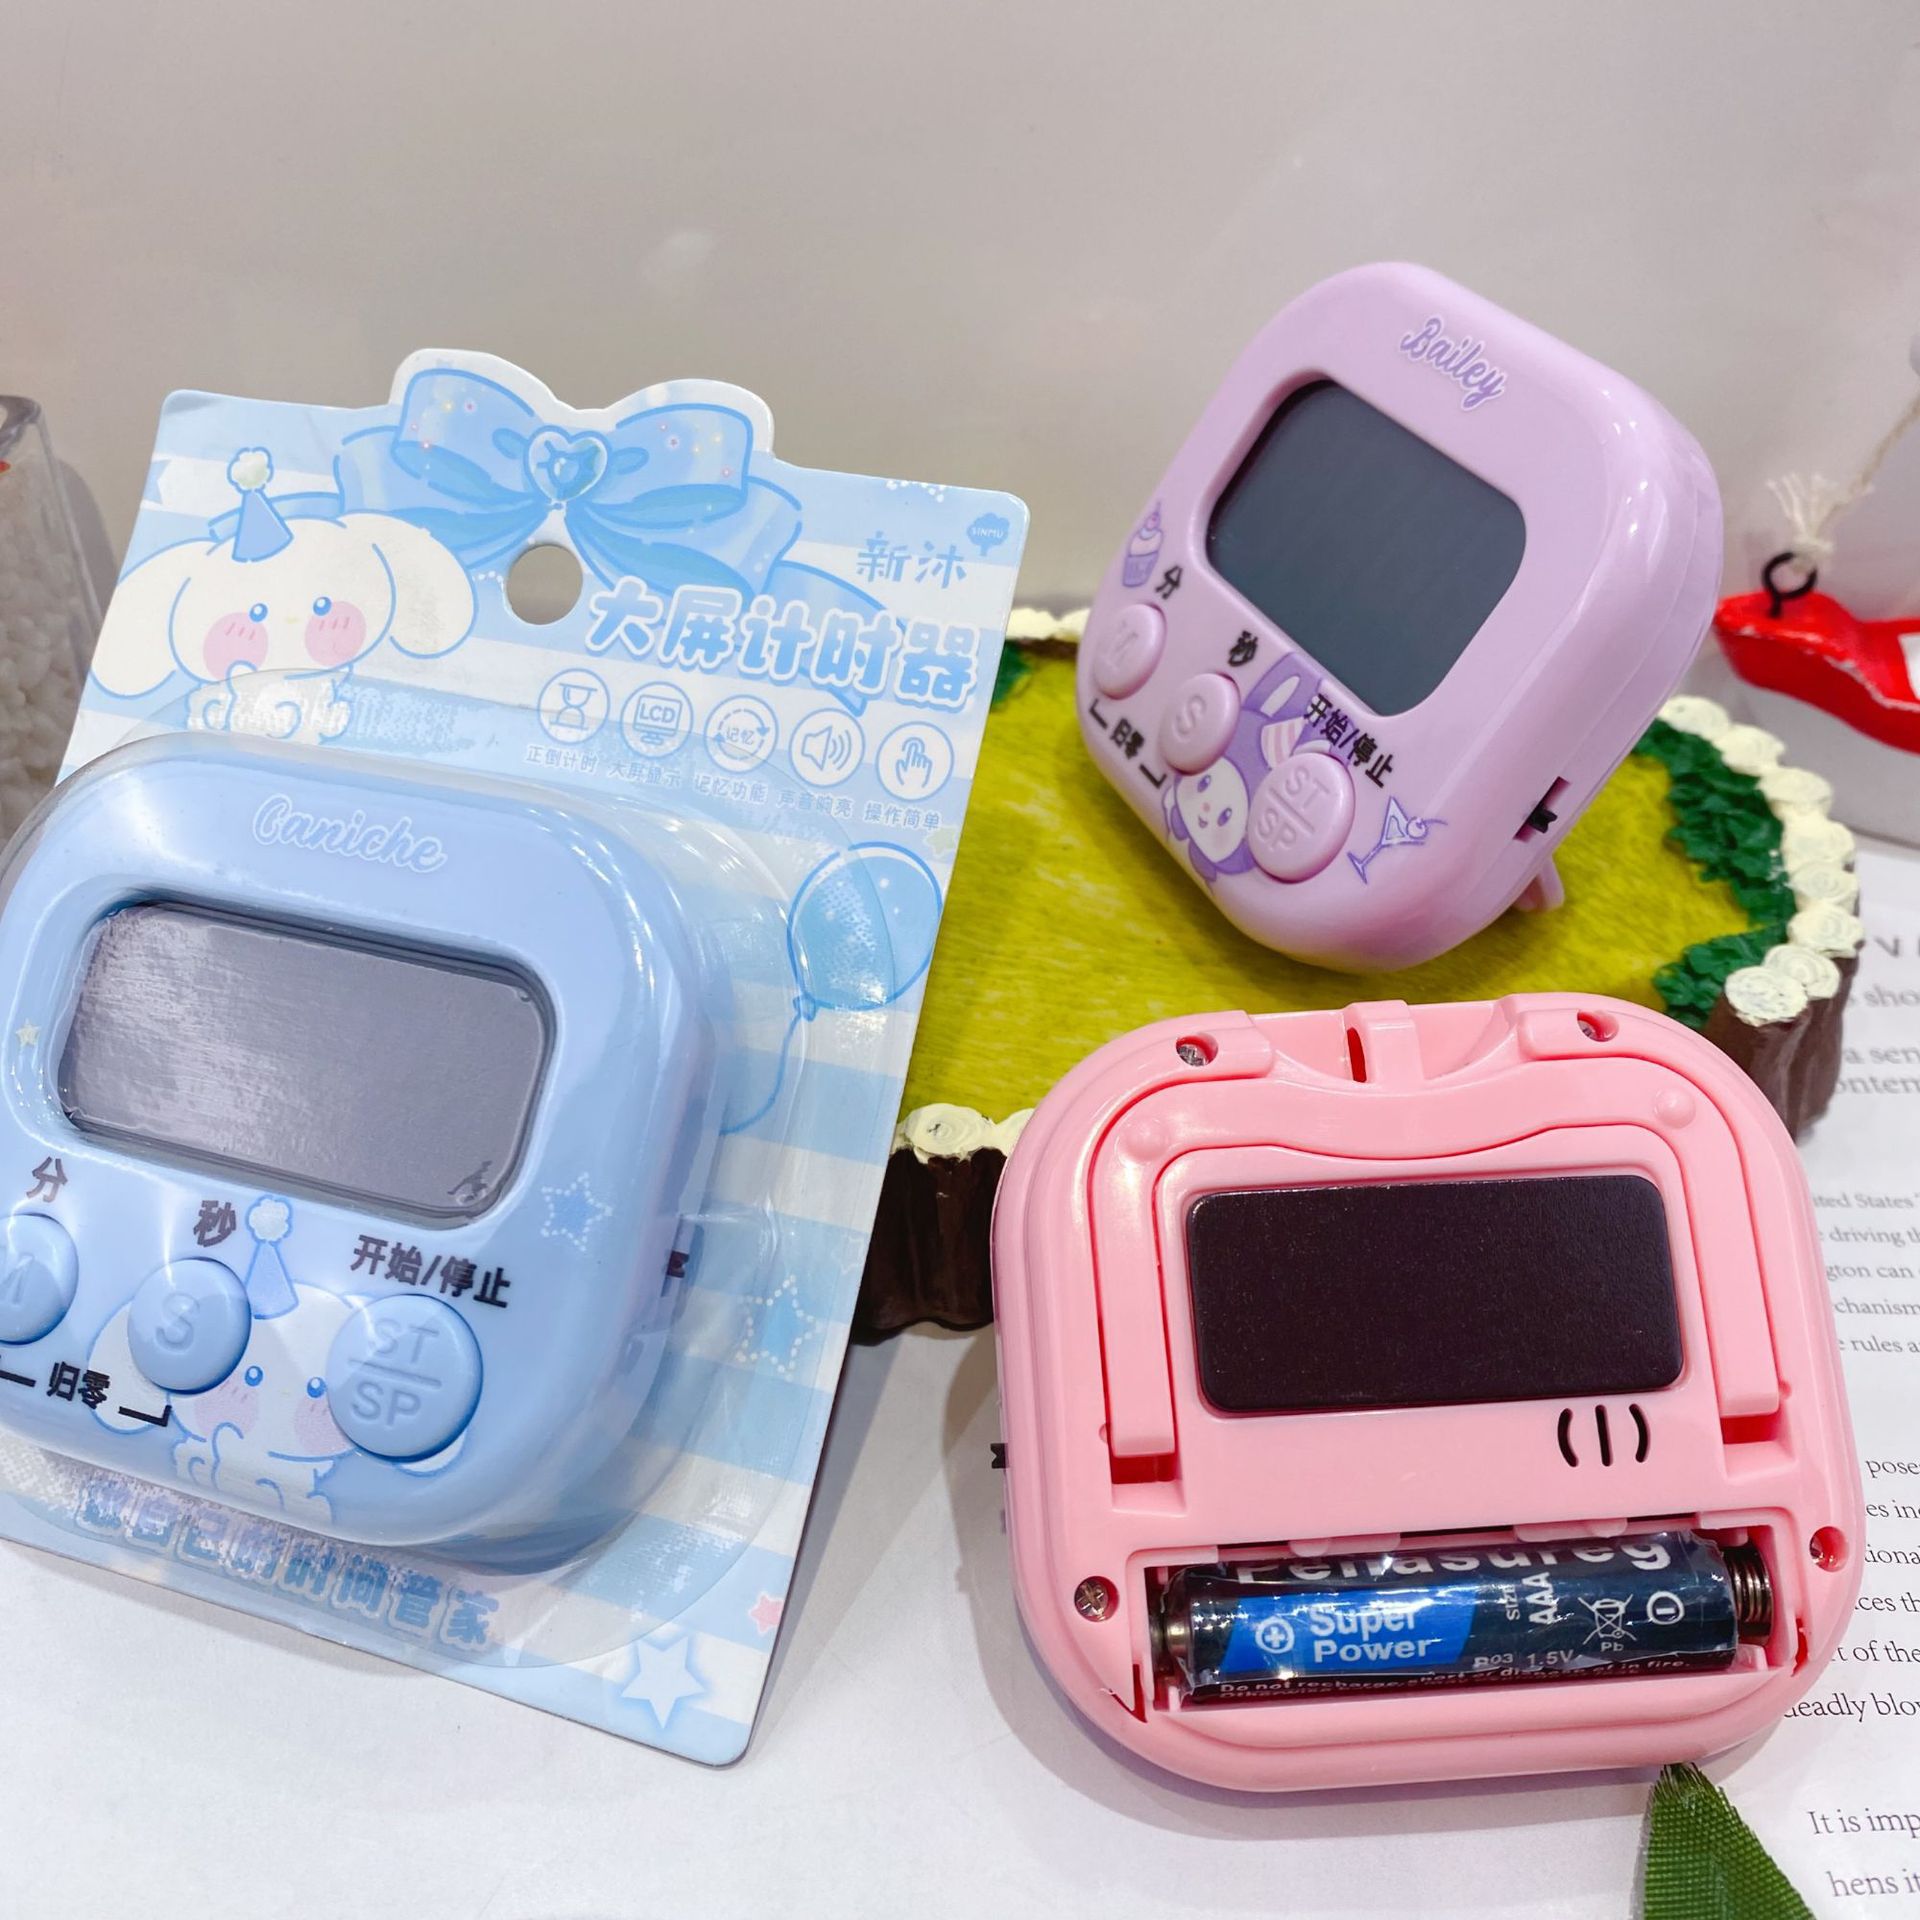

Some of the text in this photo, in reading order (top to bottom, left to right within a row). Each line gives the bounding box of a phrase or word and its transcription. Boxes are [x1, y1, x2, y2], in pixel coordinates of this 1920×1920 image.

[1399, 316, 1506, 410] Bailey
[856, 529, 968, 589] 新沐
[1154, 564, 1184, 600] 分
[585, 575, 981, 710] 大屏计时器
[638, 702, 676, 724] LCD
[725, 726, 755, 746] 记忆
[1303, 692, 1394, 789] 开始/停止
[525, 744, 599, 774] 正倒计时
[608, 761, 683, 788] 大屏显示
[694, 774, 769, 803] 记忆功能
[863, 801, 942, 831] 操作简单
[252, 793, 449, 874] Caniche
[25, 1156, 69, 1204] 分
[193, 1200, 237, 1248] 秒
[1828, 1226, 1906, 1248] driving
[349, 1233, 512, 1309] 开始/停止
[1876, 1266, 1914, 1279] can
[155, 1292, 201, 1353] S
[369, 1317, 440, 1364] ST
[1850, 1335, 1904, 1353] rules
[46, 1360, 111, 1410] 归零
[351, 1380, 422, 1428] SP
[1865, 1460, 1920, 1479] pose
[1892, 1499, 1920, 1519] in
[1521, 1571, 1558, 1625] AAA
[1308, 1603, 1416, 1641] Super
[1313, 1638, 1432, 1664] Power
[1527, 1649, 1574, 1667] 1.5V
[1600, 1641, 1625, 1652] Pb
[1853, 1640, 1878, 1662] of
[1884, 1640, 1920, 1663] the
[1220, 1683, 1249, 1693] Do
[1255, 1681, 1291, 1691] not
[1870, 1693, 1920, 1716] blo
[1807, 1807, 1920, 1839] It is imp
[1826, 1871, 1899, 1897] hens
